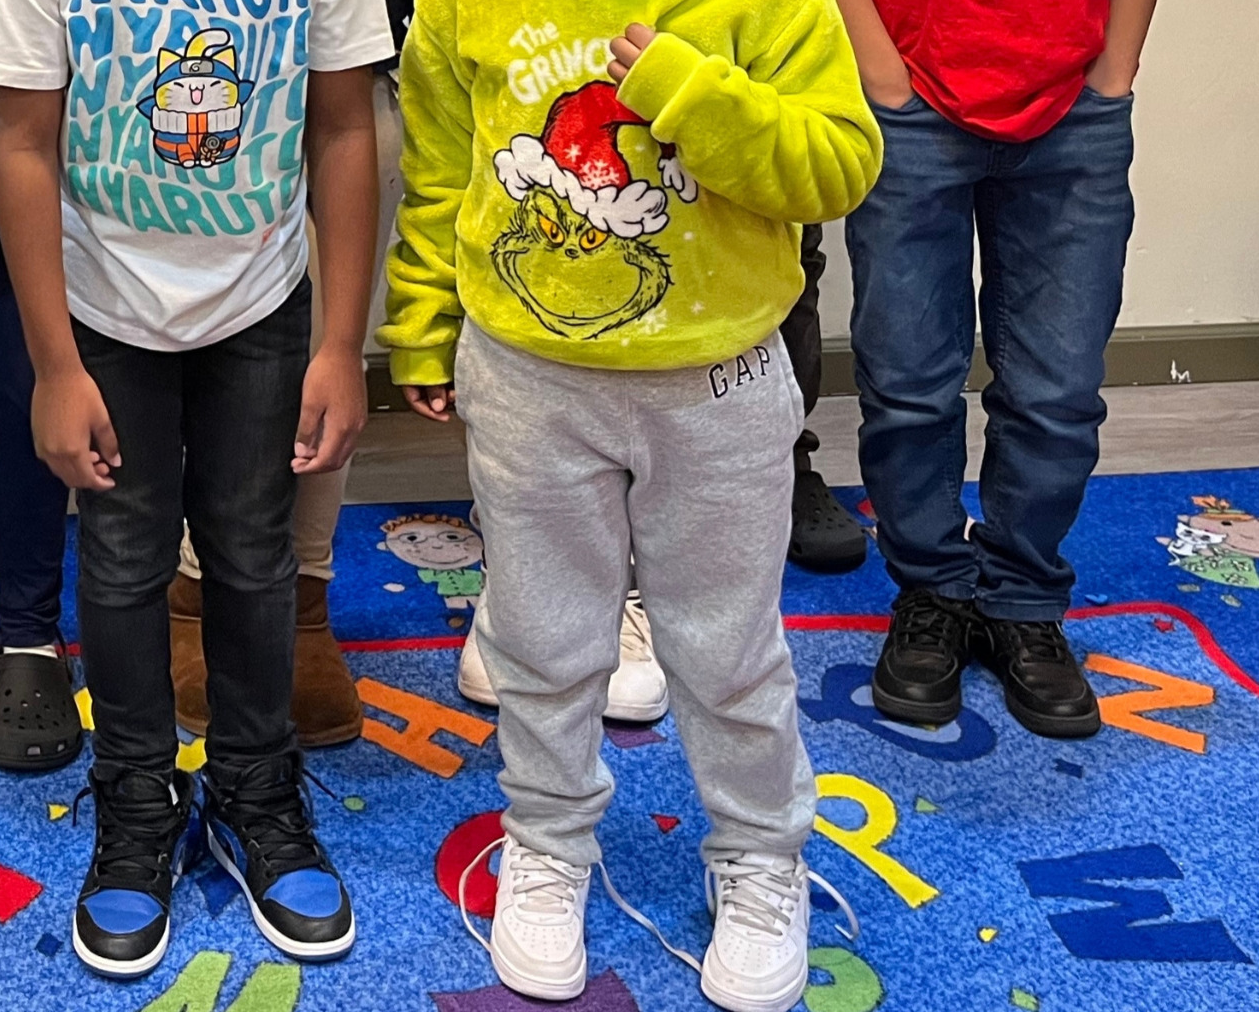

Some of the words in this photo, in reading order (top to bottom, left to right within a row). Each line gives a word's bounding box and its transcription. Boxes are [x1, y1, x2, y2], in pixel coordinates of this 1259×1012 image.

[509, 21, 559, 55] The
[507, 38, 617, 105] GRINC
[709, 346, 770, 399] GAP
